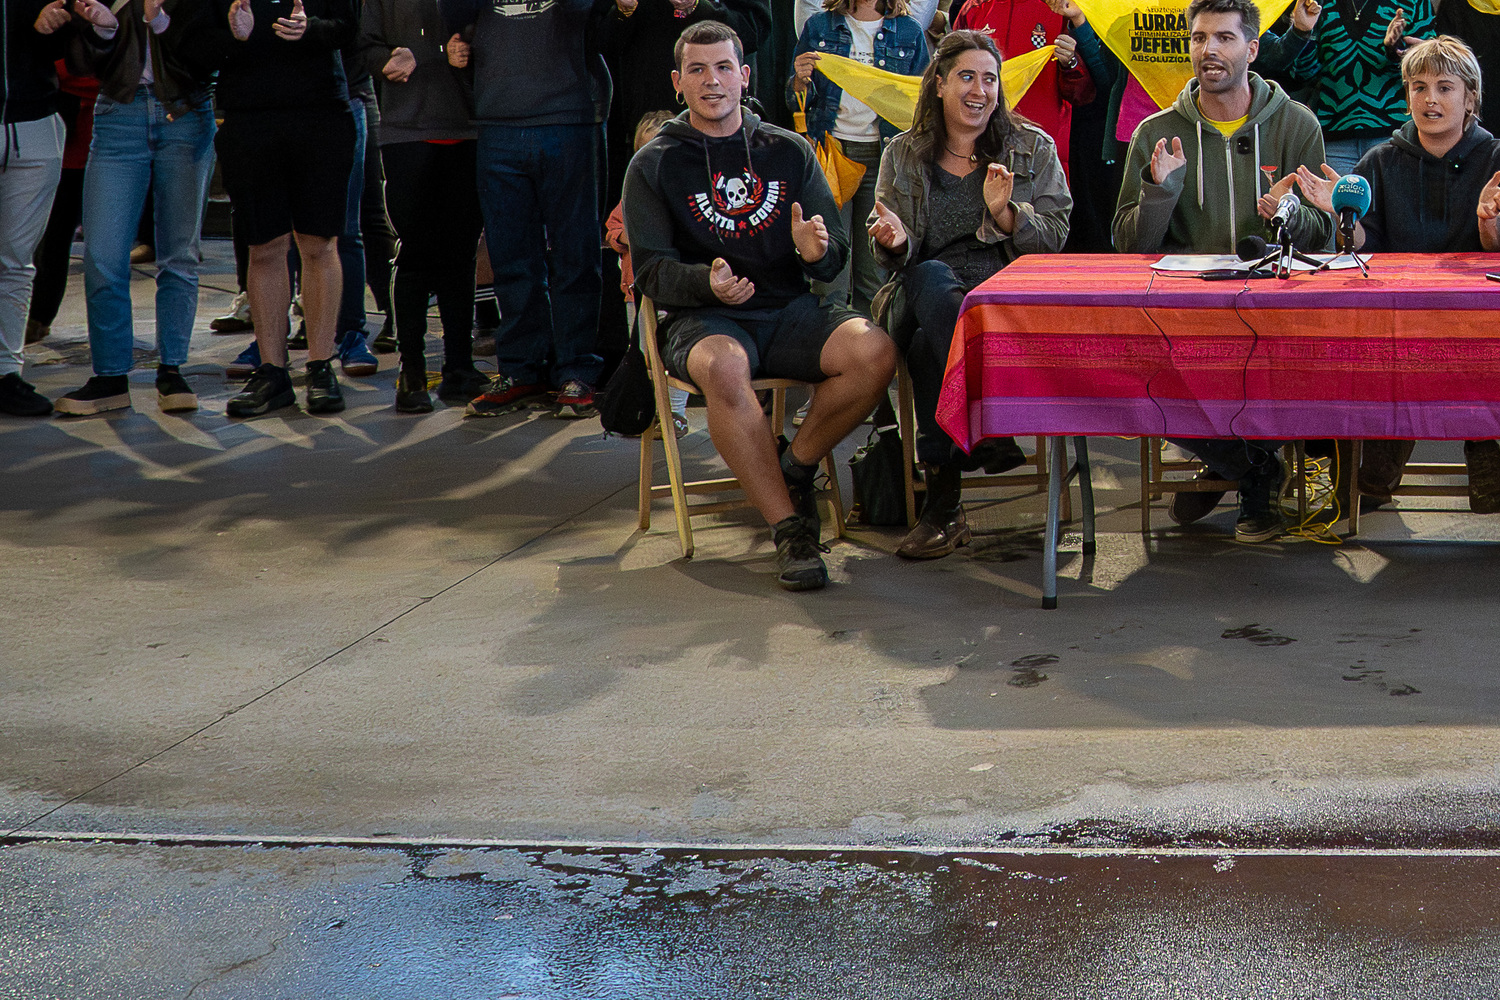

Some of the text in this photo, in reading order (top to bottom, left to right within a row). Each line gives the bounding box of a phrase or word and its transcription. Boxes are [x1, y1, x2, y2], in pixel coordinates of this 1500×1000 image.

[1131, 53, 1191, 63] ABSOLUZIOA
[695, 192, 735, 231] ALERTA
[749, 180, 780, 226] GORRIA
